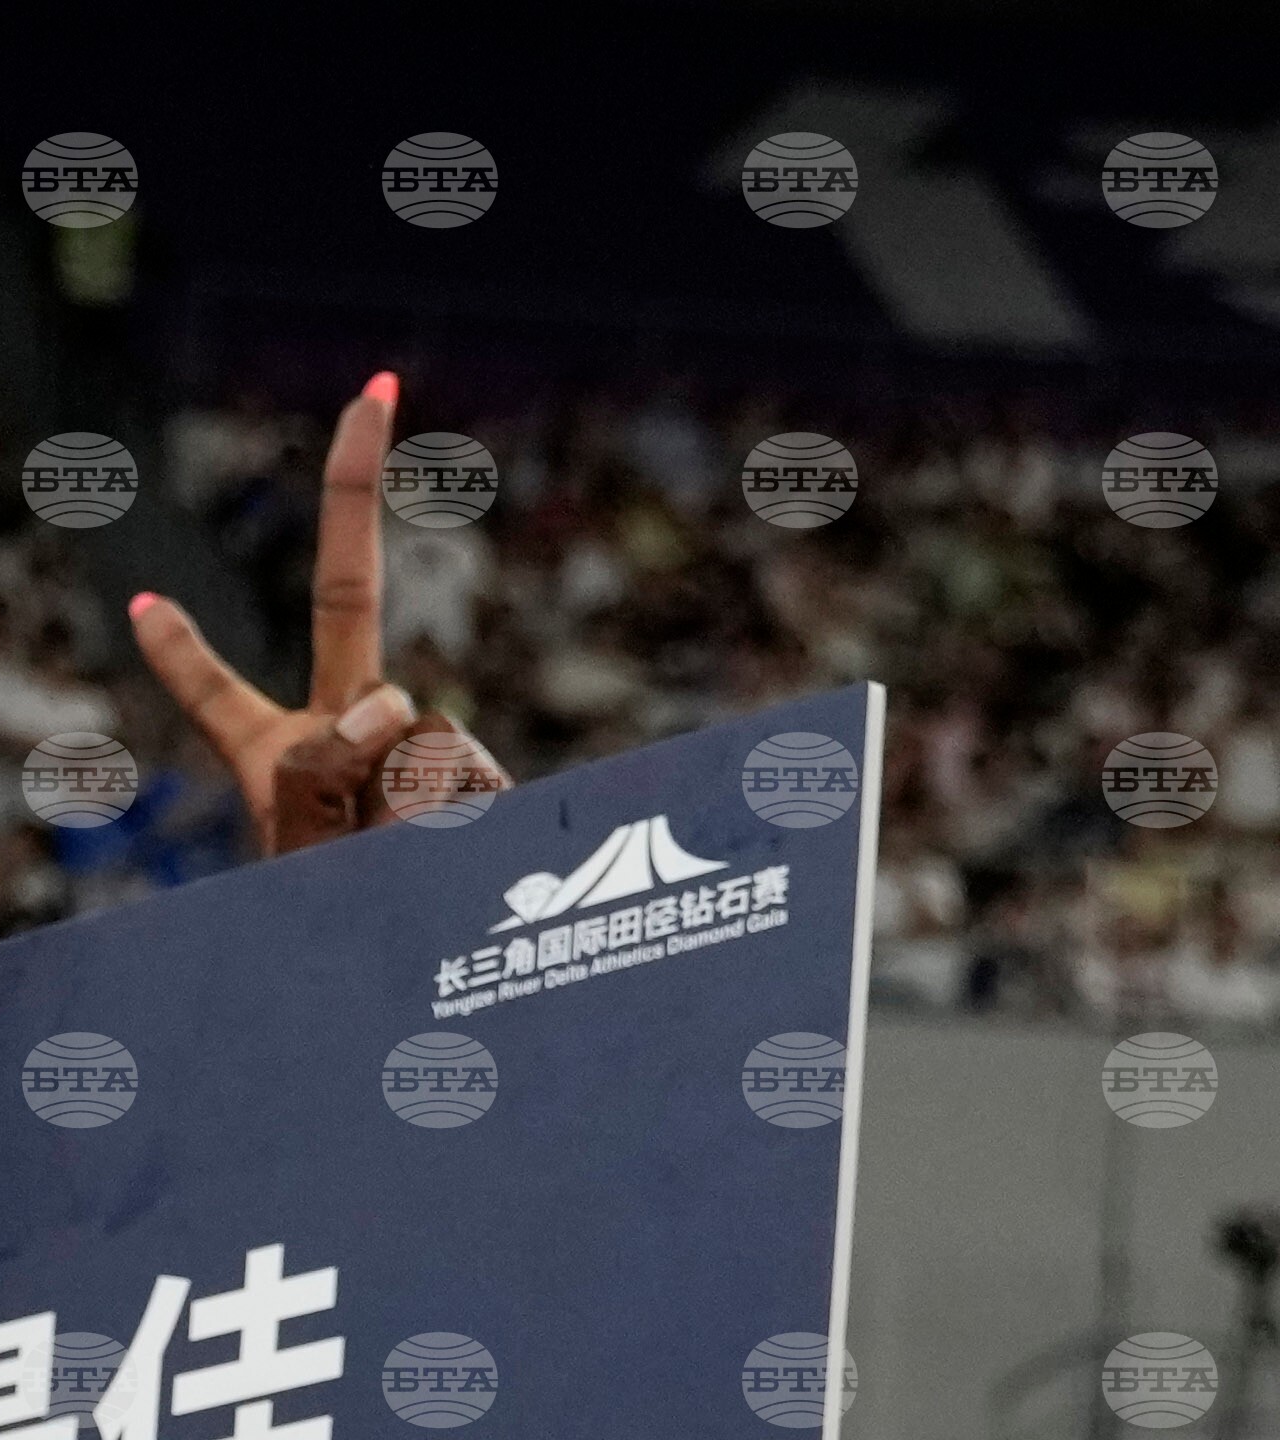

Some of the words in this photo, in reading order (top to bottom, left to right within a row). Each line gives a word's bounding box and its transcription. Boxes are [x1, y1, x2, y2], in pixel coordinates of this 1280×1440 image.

[434, 864, 790, 998] 长三角国际田径钻石赛
[498, 976, 541, 1001] River
[544, 962, 589, 989] Delta
[590, 941, 665, 977] Athletics
[666, 917, 745, 956] Diamond
[746, 908, 789, 933] Gala
